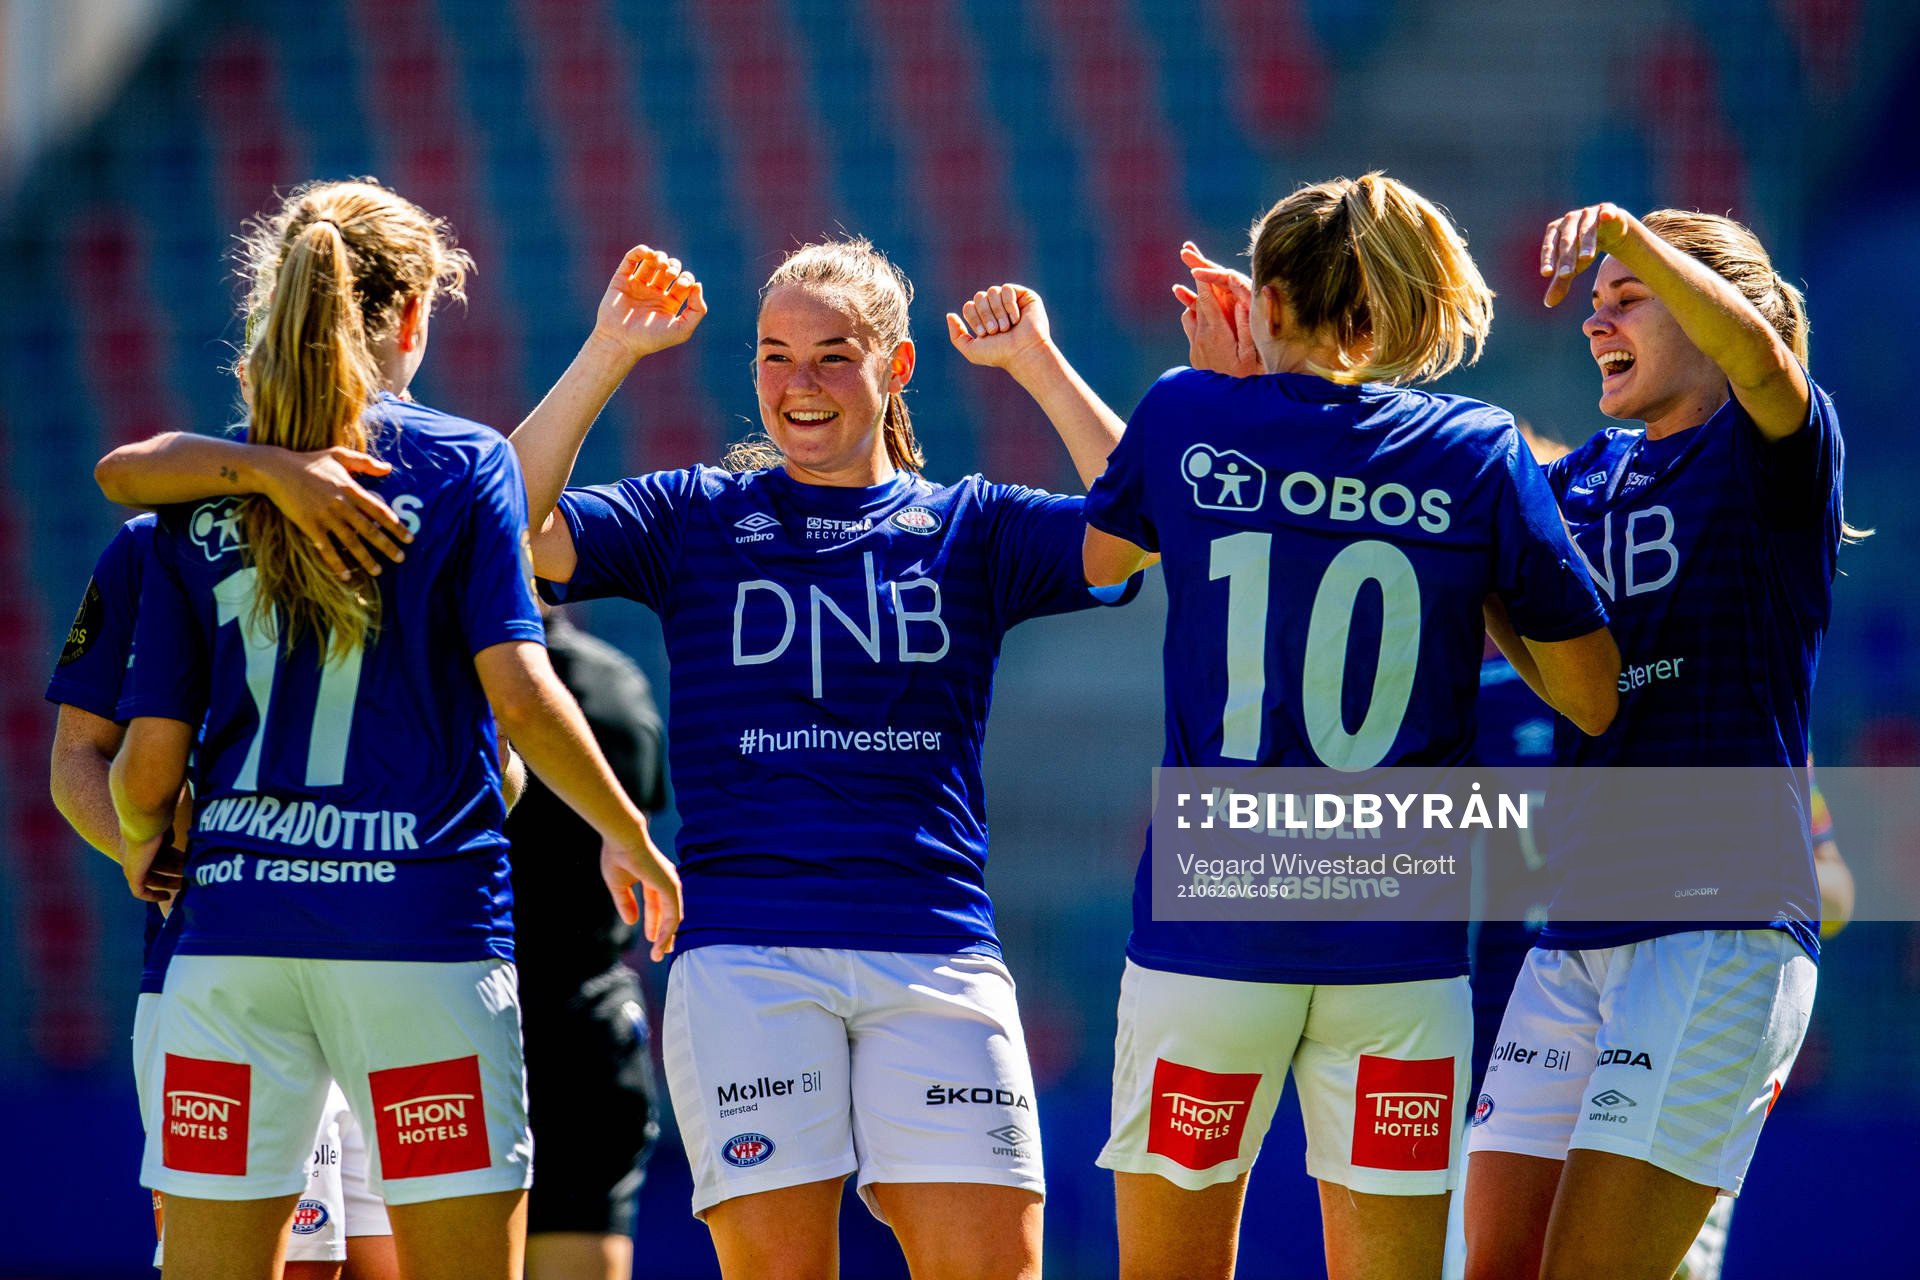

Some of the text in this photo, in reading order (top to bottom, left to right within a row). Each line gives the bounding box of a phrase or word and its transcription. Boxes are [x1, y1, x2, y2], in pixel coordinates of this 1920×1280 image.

[1280, 471, 1452, 533] OBOS
[735, 531, 774, 543] umbro
[733, 551, 950, 699] DNB
[1209, 531, 1421, 772] 10
[739, 724, 942, 755] #huninvesterer
[198, 796, 419, 851] ANDRADOTTIR
[196, 853, 396, 886] mot rasisme
[1544, 1048, 1571, 1072] Bil
[1597, 1049, 1652, 1070] ODA
[802, 1070, 822, 1093] Bil
[167, 1091, 241, 1122] THON
[384, 1094, 475, 1127] THON
[926, 1084, 1030, 1112] ŠKODA
[1162, 1093, 1244, 1125] THON
[1366, 1092, 1447, 1119] THON
[170, 1120, 228, 1140] HOTELS
[398, 1123, 468, 1145] HOTELS
[1170, 1117, 1230, 1140] HOTELS
[1375, 1121, 1439, 1137] HOTELS
